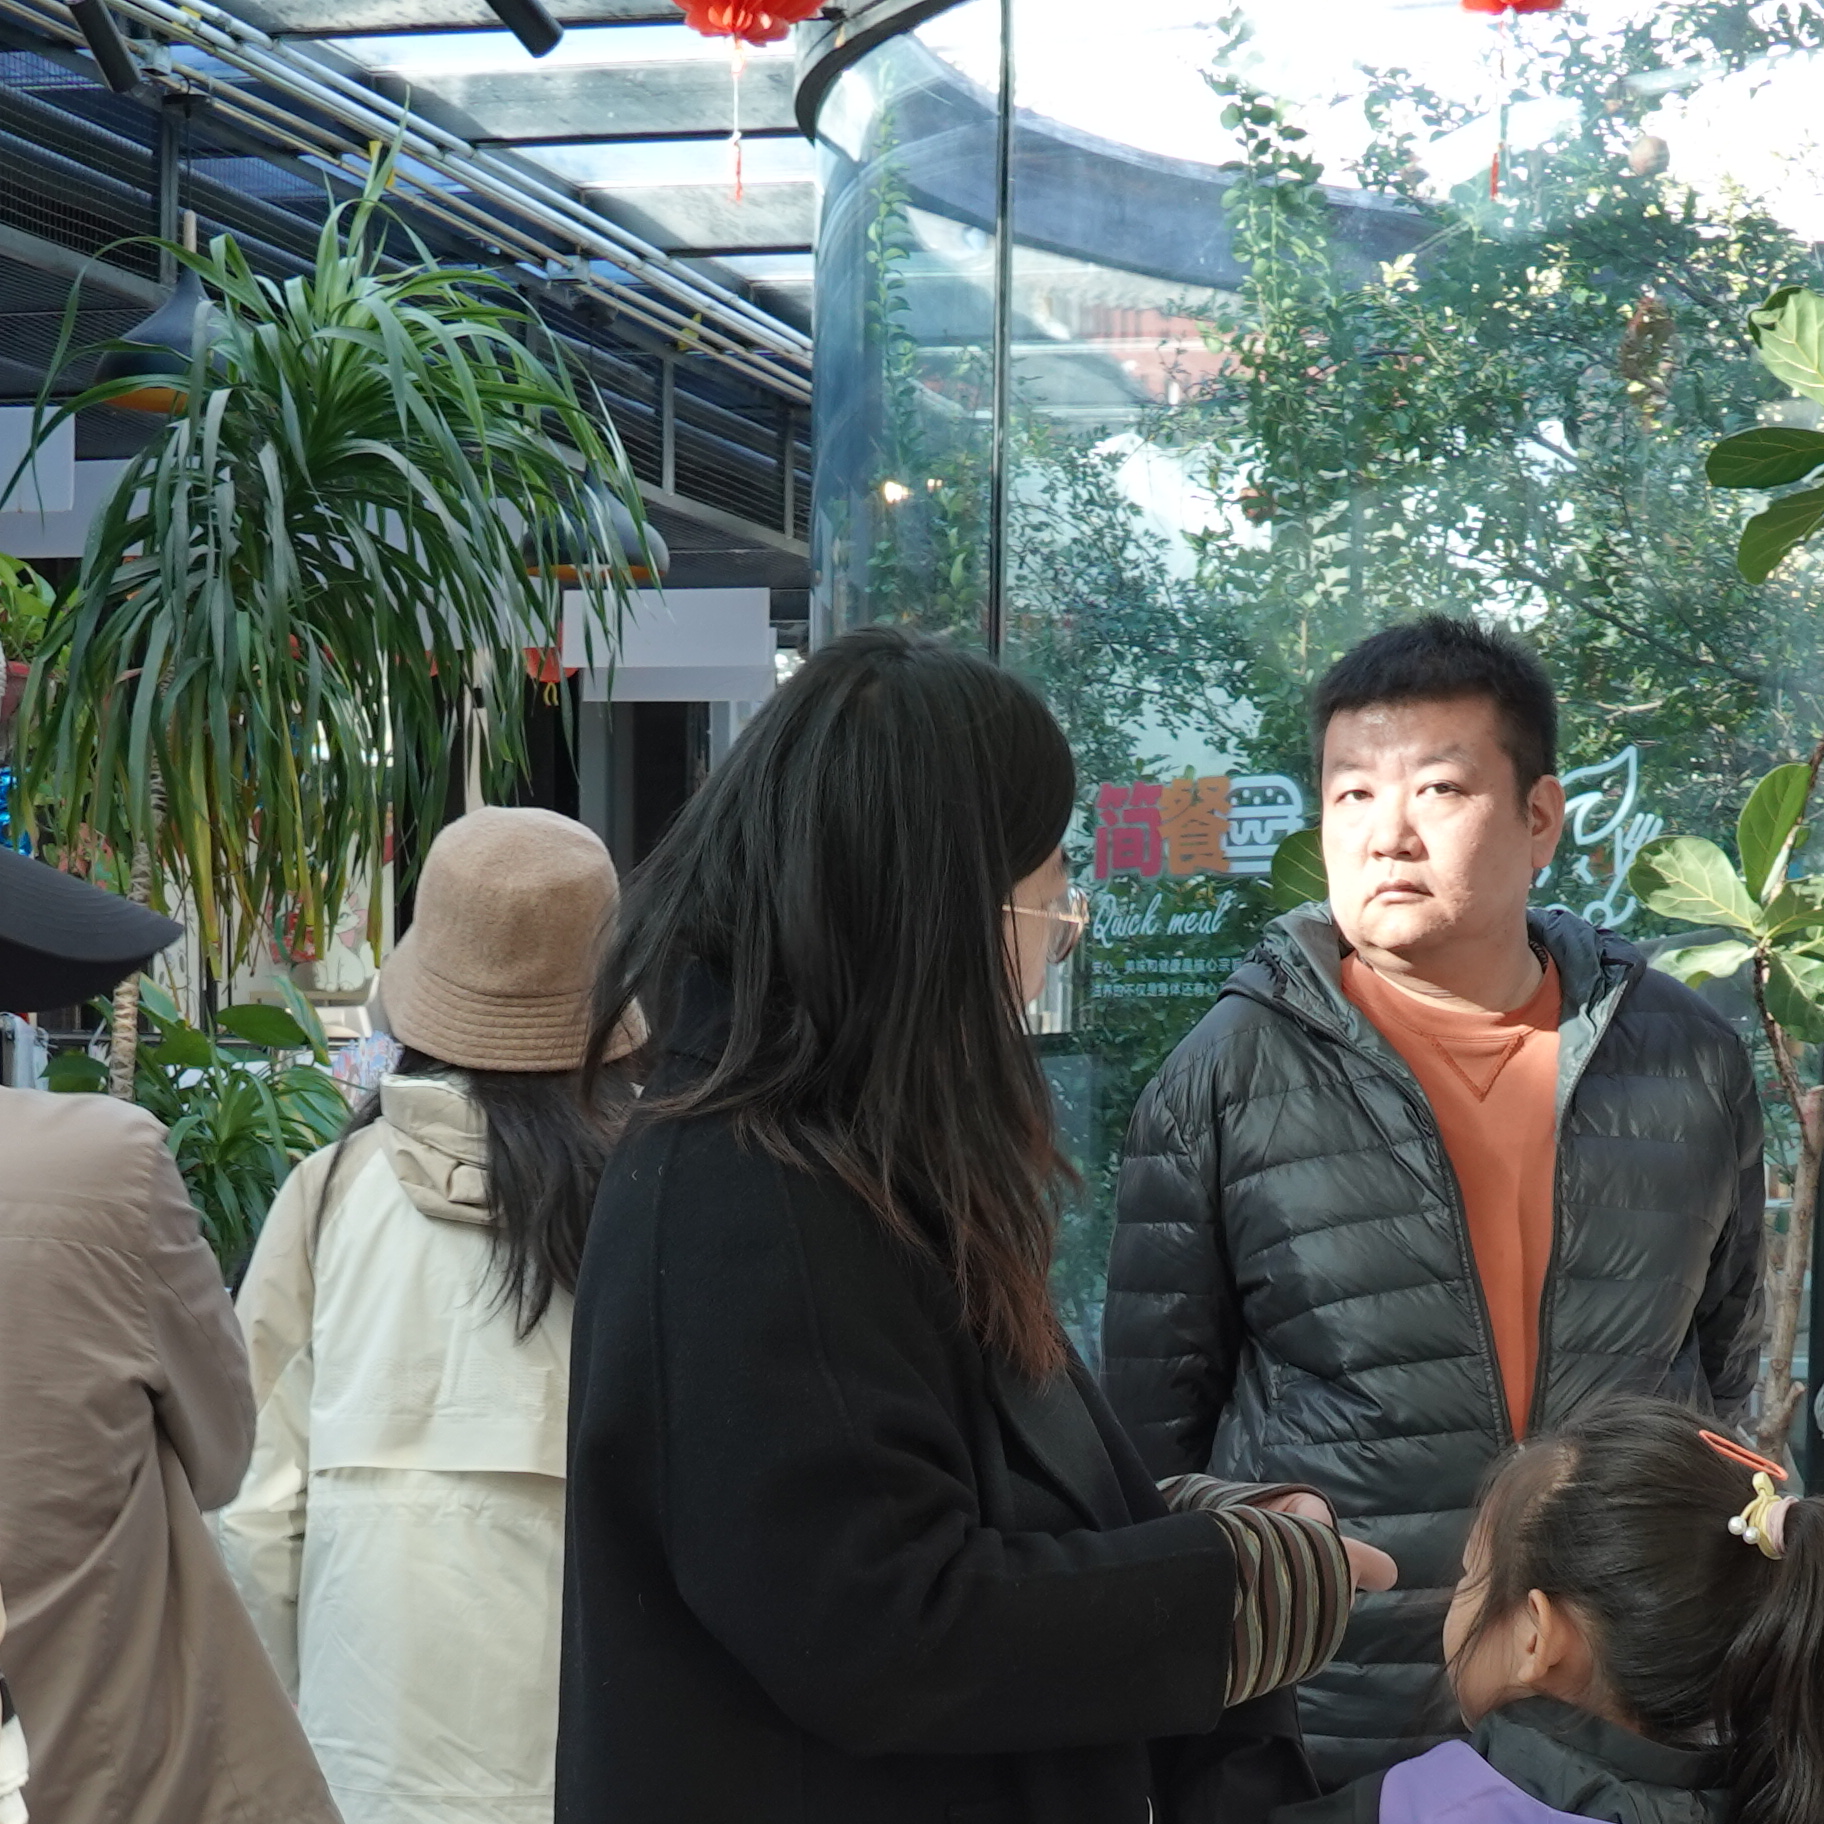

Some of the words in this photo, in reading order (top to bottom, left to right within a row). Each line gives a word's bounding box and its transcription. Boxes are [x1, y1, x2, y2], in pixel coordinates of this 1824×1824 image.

[1094, 775, 1231, 880] 简餐
[1093, 892, 1163, 949] Quick
[1167, 890, 1238, 935] meal
